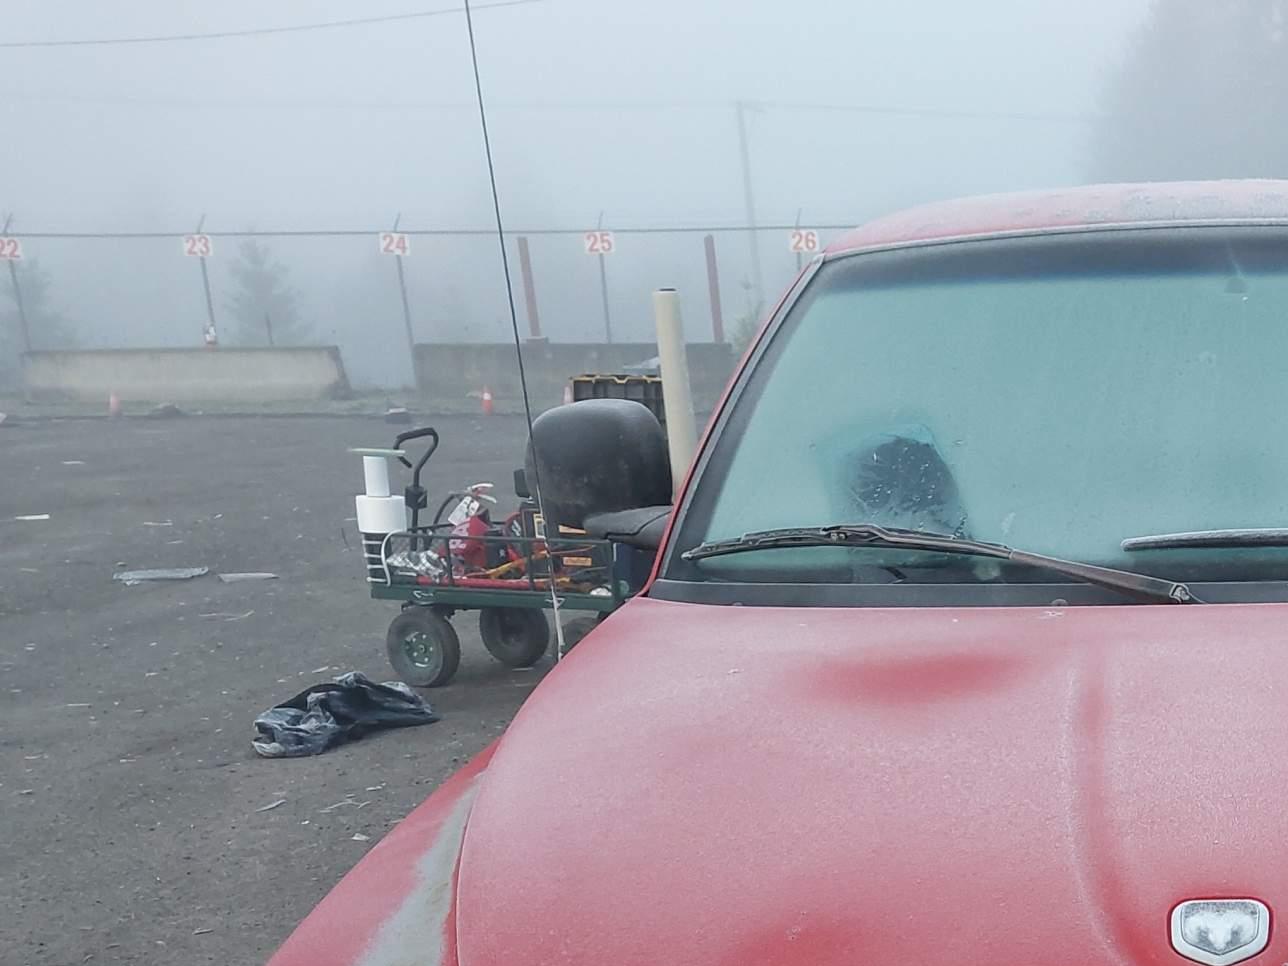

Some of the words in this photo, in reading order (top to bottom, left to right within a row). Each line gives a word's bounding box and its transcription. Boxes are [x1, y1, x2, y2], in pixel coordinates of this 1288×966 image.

[185, 236, 210, 255] 23
[382, 234, 408, 254] 24
[585, 233, 612, 252] 25
[791, 231, 817, 251] 26
